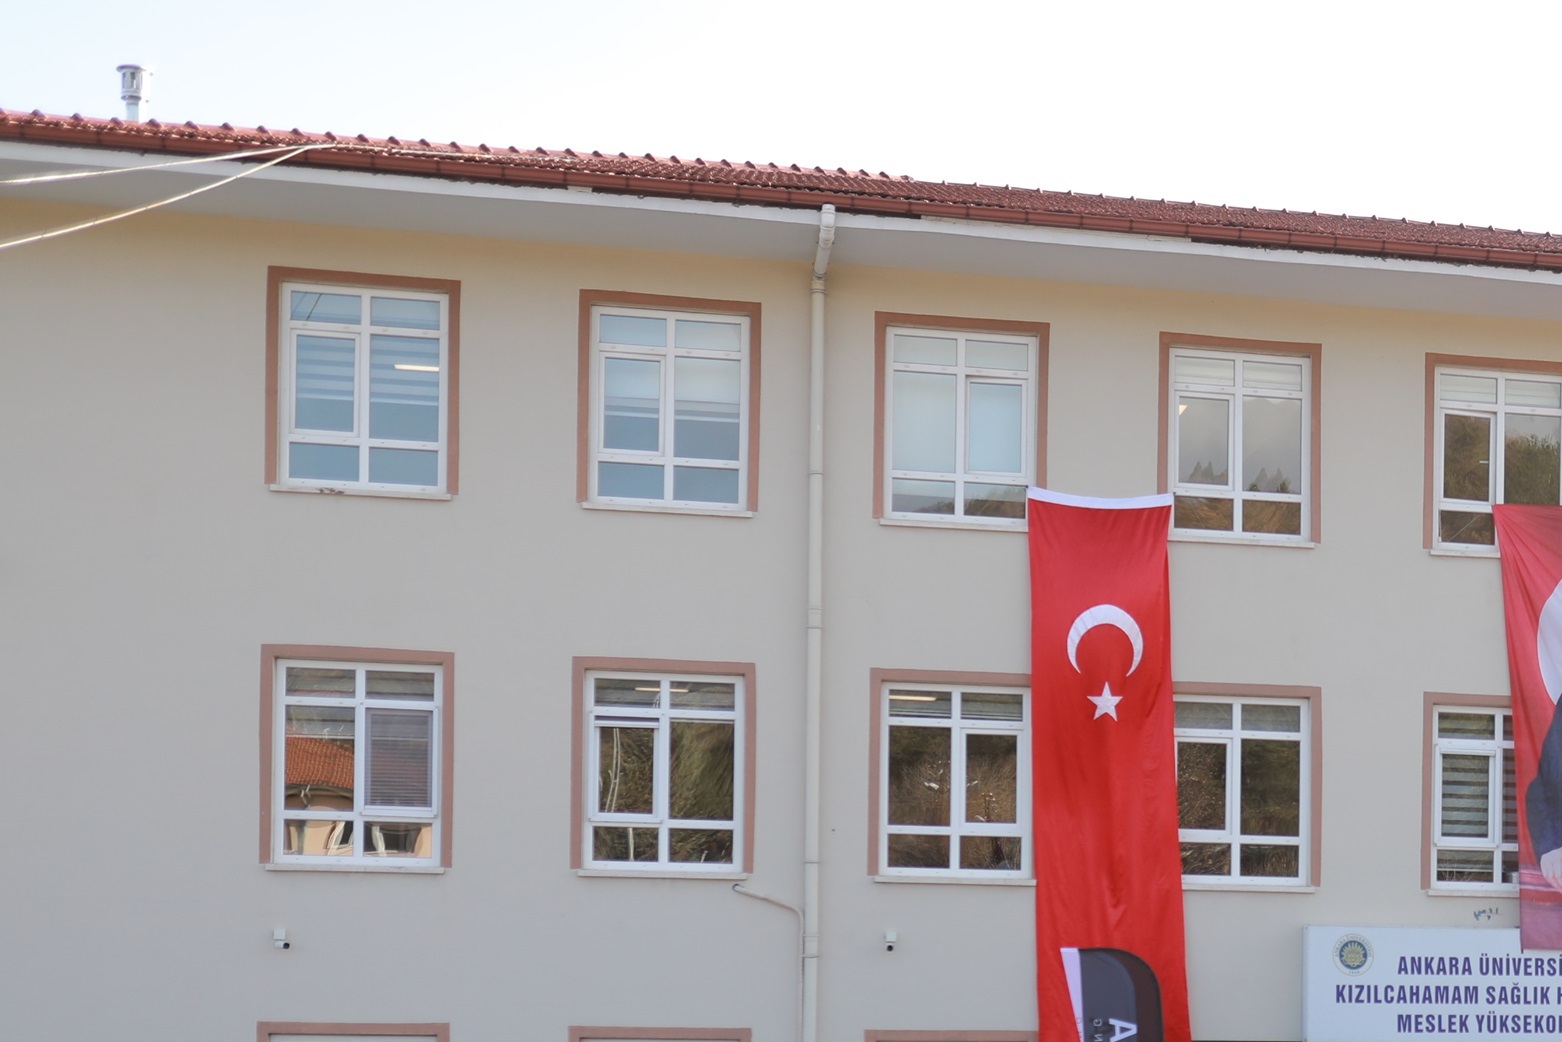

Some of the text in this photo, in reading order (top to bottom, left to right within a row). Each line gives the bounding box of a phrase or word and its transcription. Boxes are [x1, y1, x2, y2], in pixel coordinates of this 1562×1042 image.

[1397, 955, 1473, 977] ANKARA
[1335, 984, 1479, 1006] KIZILCAHAMAM
[1485, 982, 1550, 1006] SAĞLIK
[1397, 1013, 1470, 1034] MESLEK
